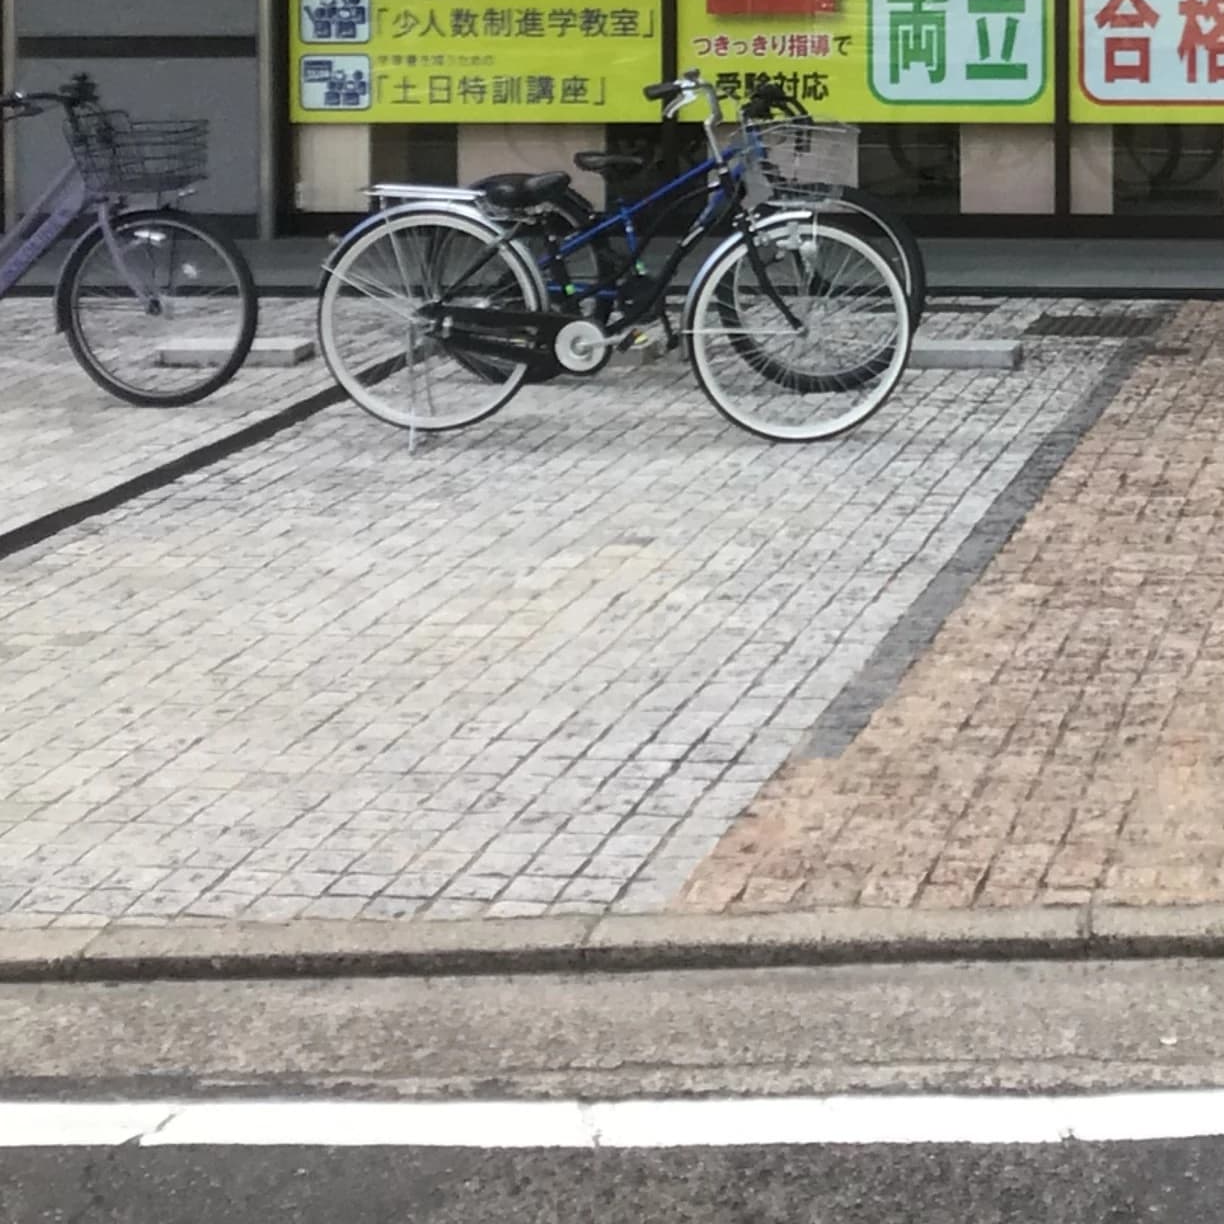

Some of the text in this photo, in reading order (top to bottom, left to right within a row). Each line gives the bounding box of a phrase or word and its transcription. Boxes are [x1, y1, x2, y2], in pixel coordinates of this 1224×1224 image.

[376, 7, 656, 39] 「少人数制進学教室」
[692, 33, 853, 58] つきっきり指導で
[376, 75, 607, 107] 「土日特訓講座」
[715, 71, 830, 102] 受験対応
